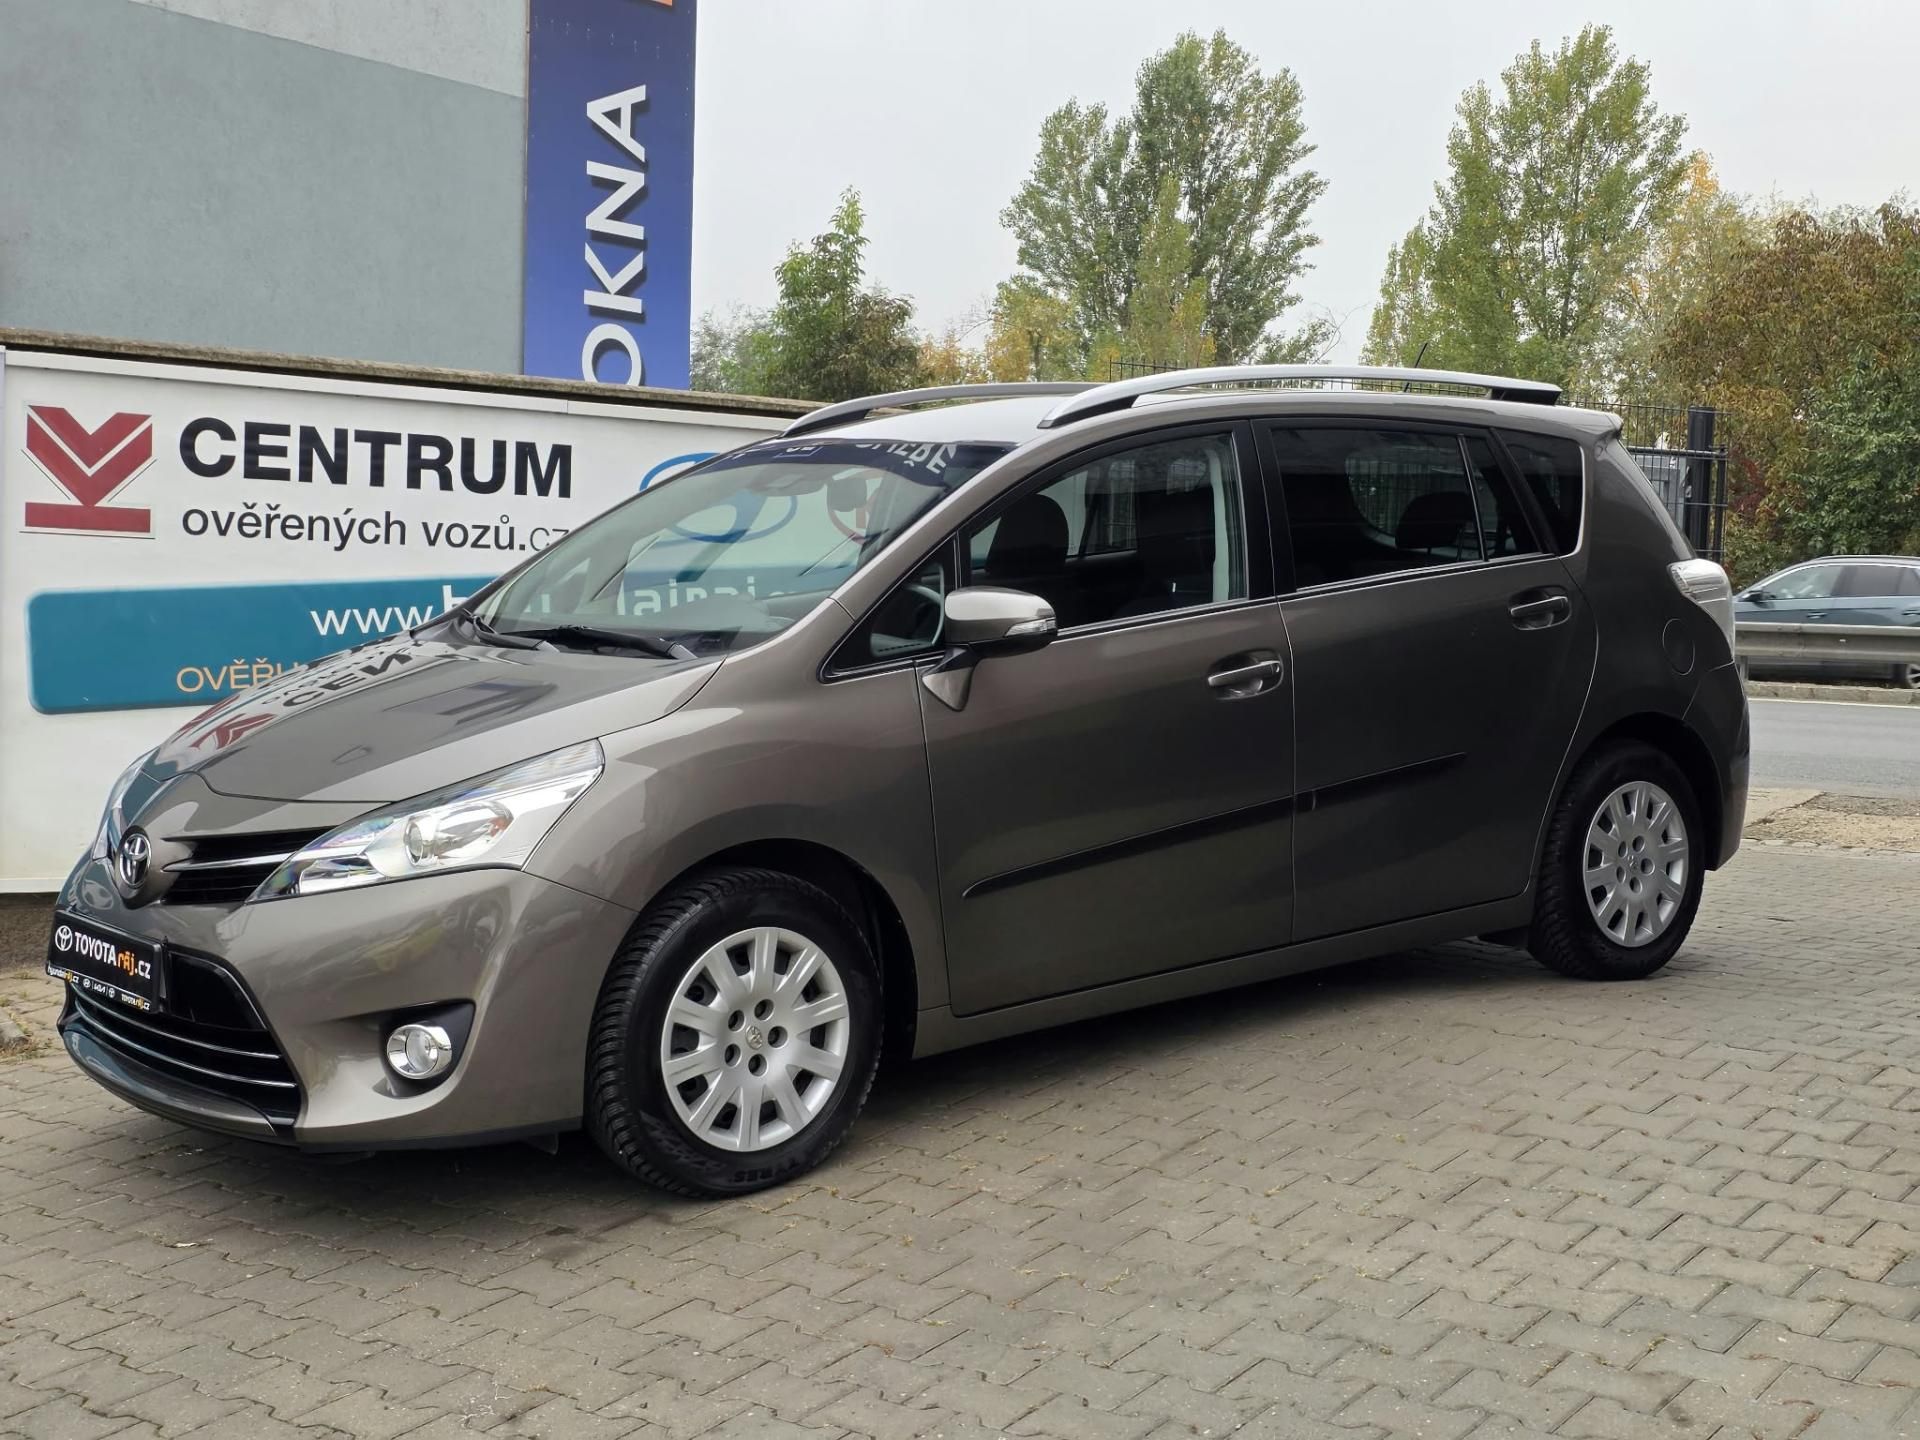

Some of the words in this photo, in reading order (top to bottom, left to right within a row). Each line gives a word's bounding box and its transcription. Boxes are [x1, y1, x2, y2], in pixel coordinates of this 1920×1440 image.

[581, 84, 646, 387] OKNA
[178, 416, 573, 499] CENTRUM
[182, 502, 407, 552] ověřených
